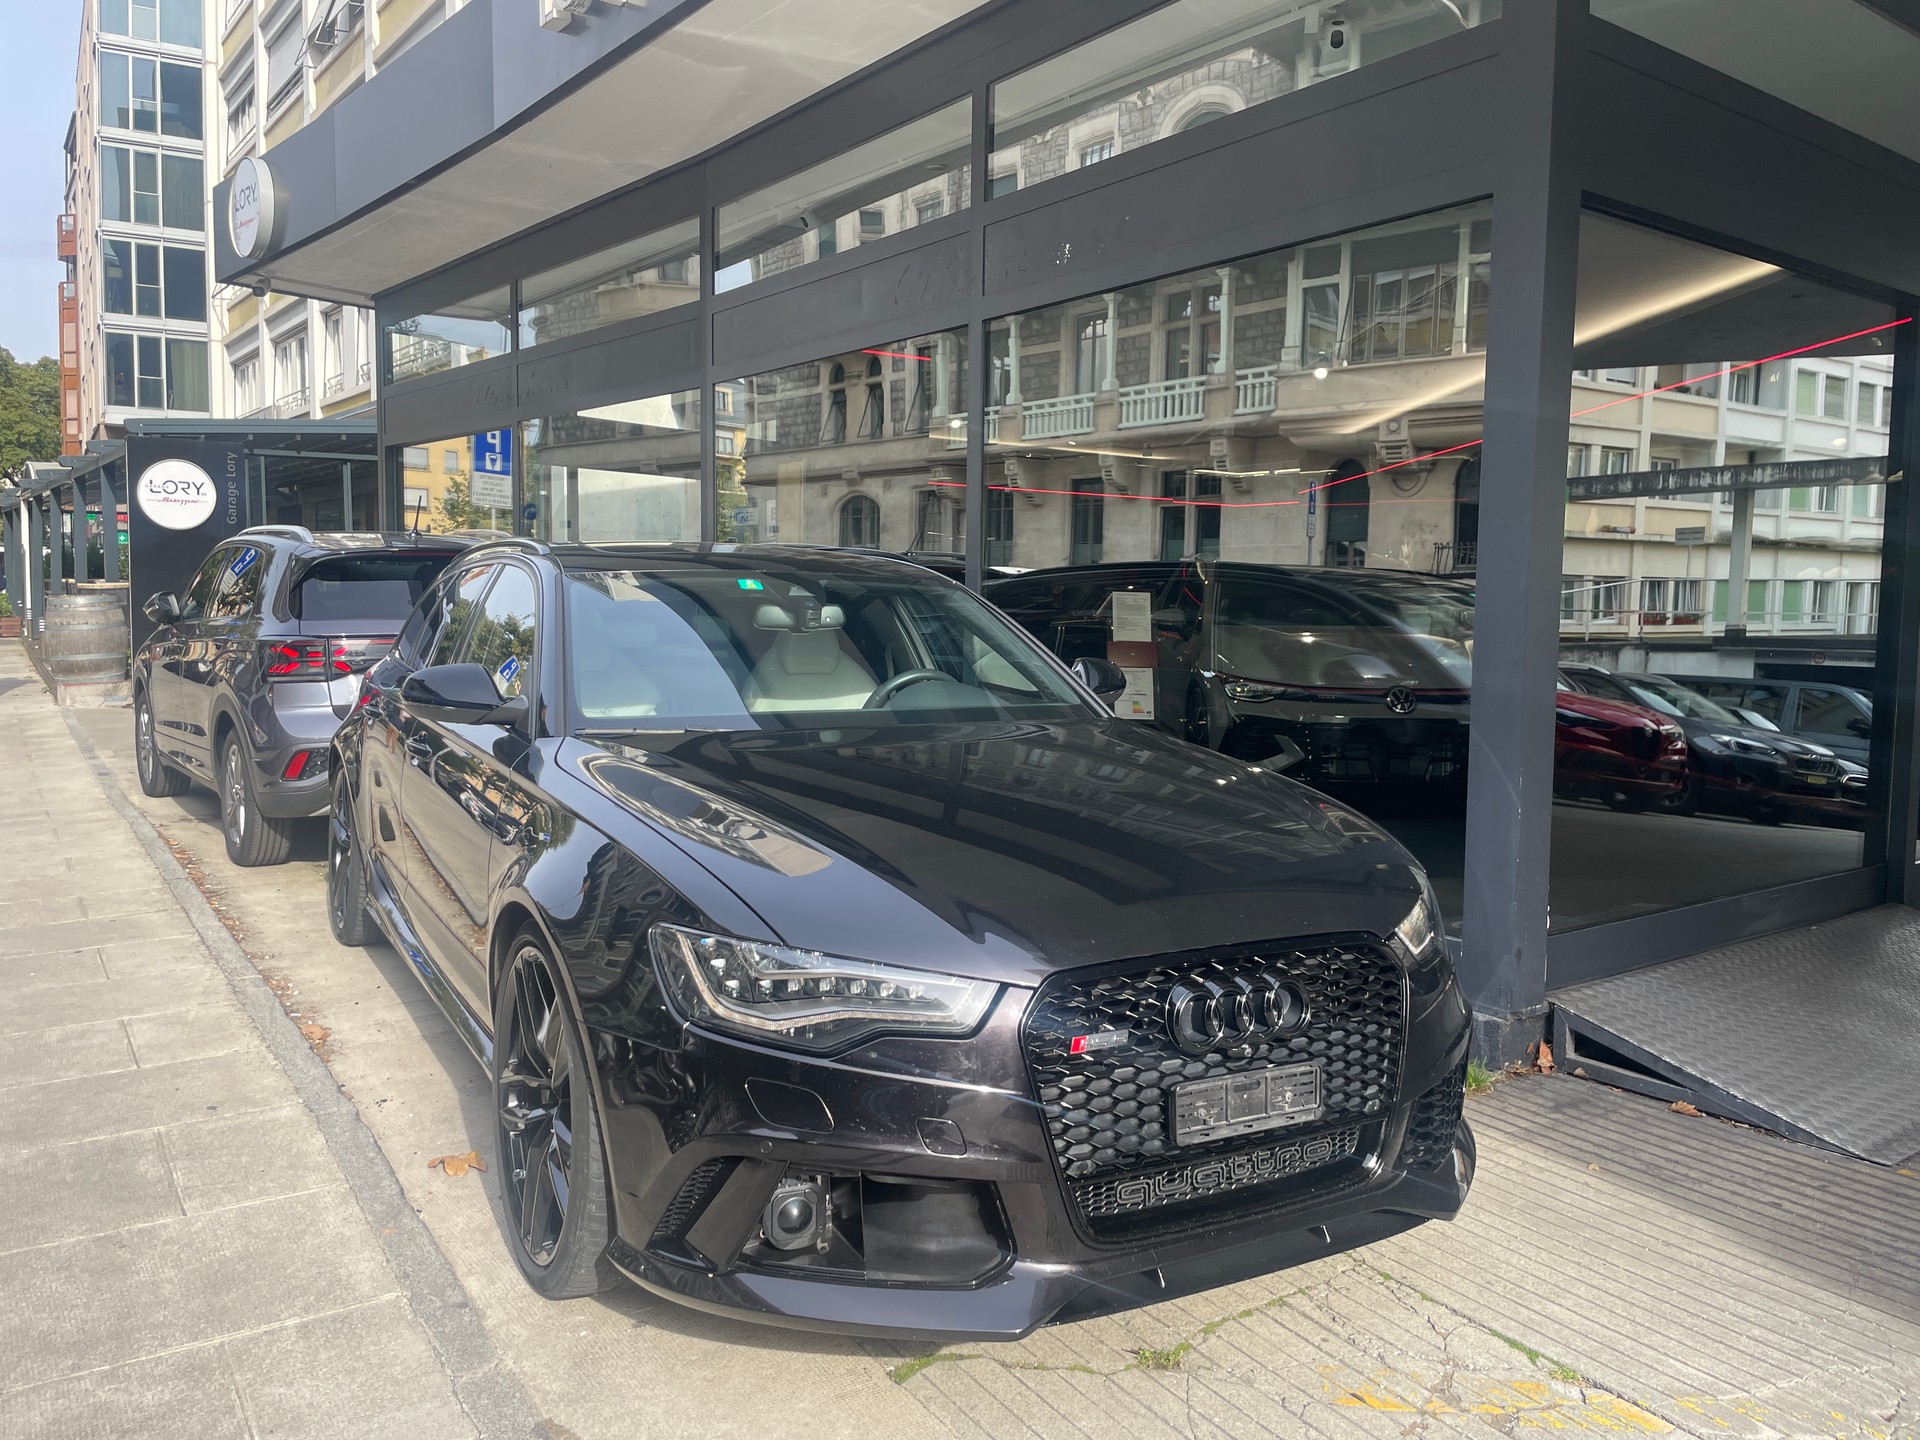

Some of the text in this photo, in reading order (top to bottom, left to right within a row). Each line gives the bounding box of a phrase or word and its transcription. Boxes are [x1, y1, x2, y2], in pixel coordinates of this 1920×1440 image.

[234, 182, 257, 213] LORY
[149, 479, 205, 496] LORY
[226, 452, 239, 525] Garage Lory
[1116, 1138, 1333, 1207] quattro
